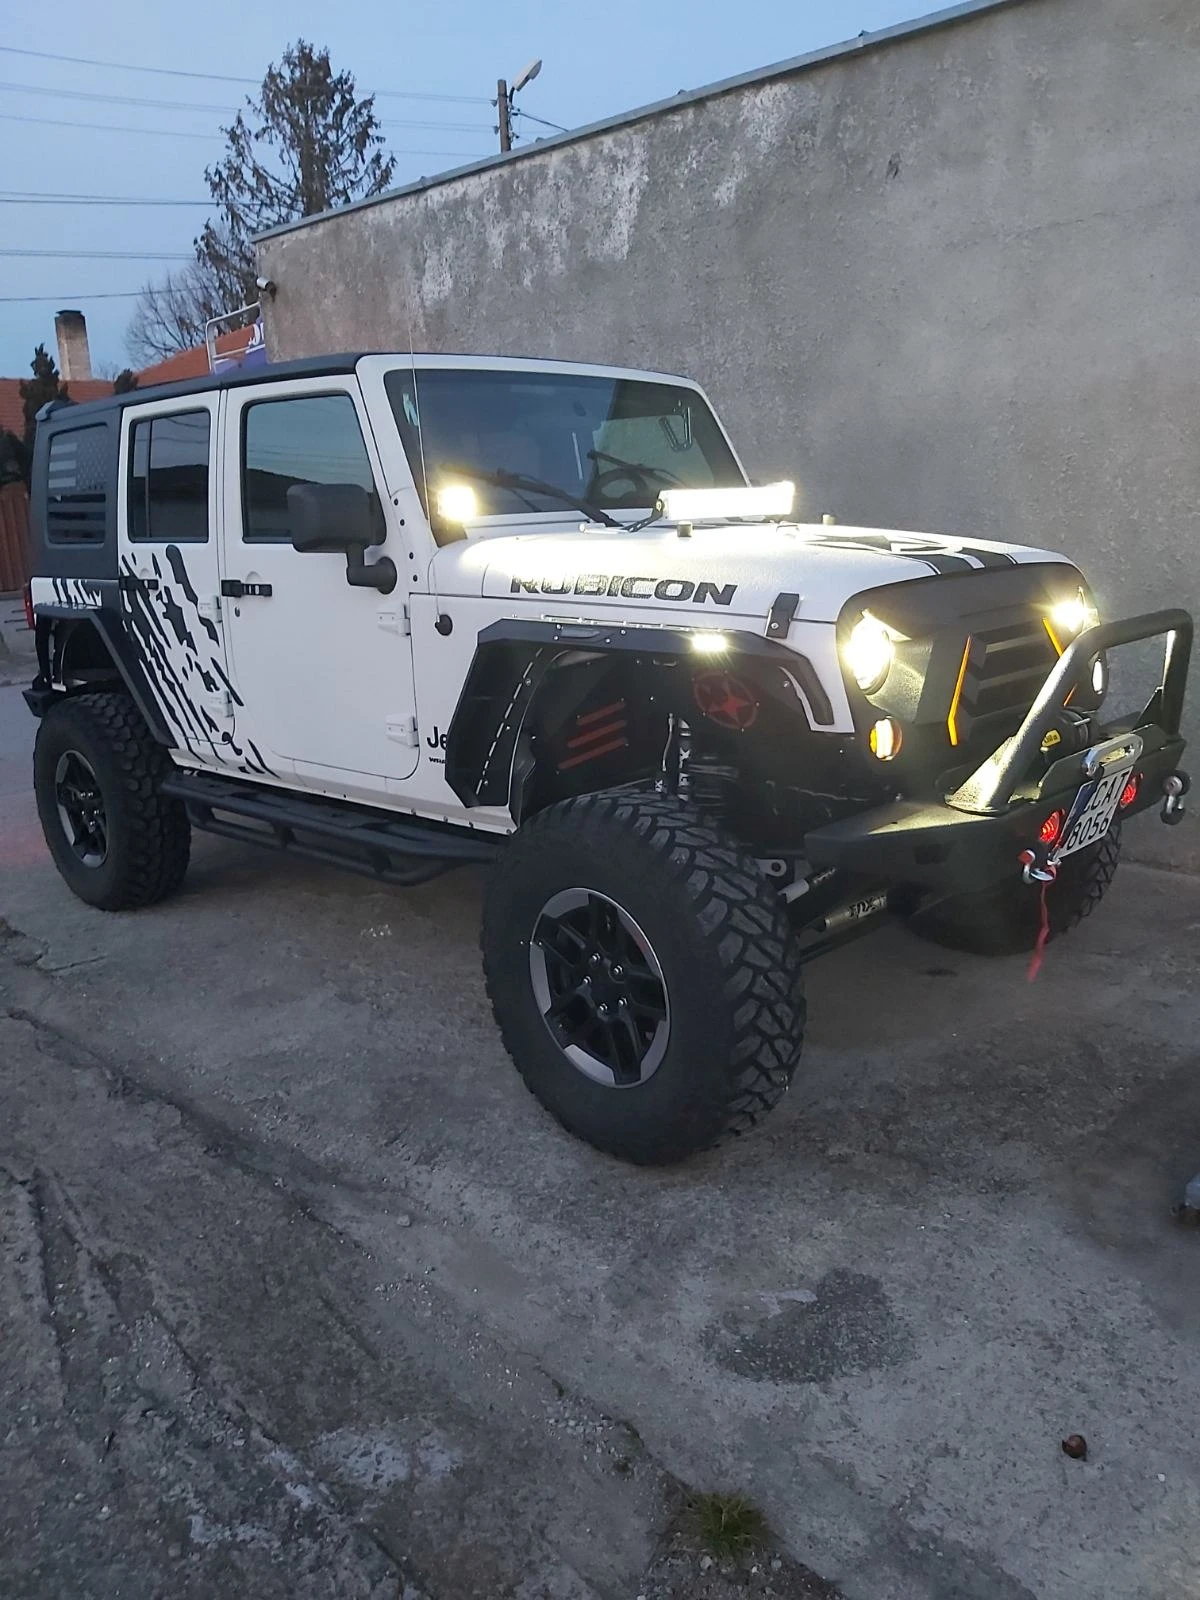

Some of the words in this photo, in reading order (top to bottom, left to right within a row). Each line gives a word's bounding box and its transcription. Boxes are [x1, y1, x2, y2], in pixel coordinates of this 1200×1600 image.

[510, 574, 738, 606] RUBICON
[1084, 770, 1130, 813] CAT
[1066, 806, 1113, 850] 8056
